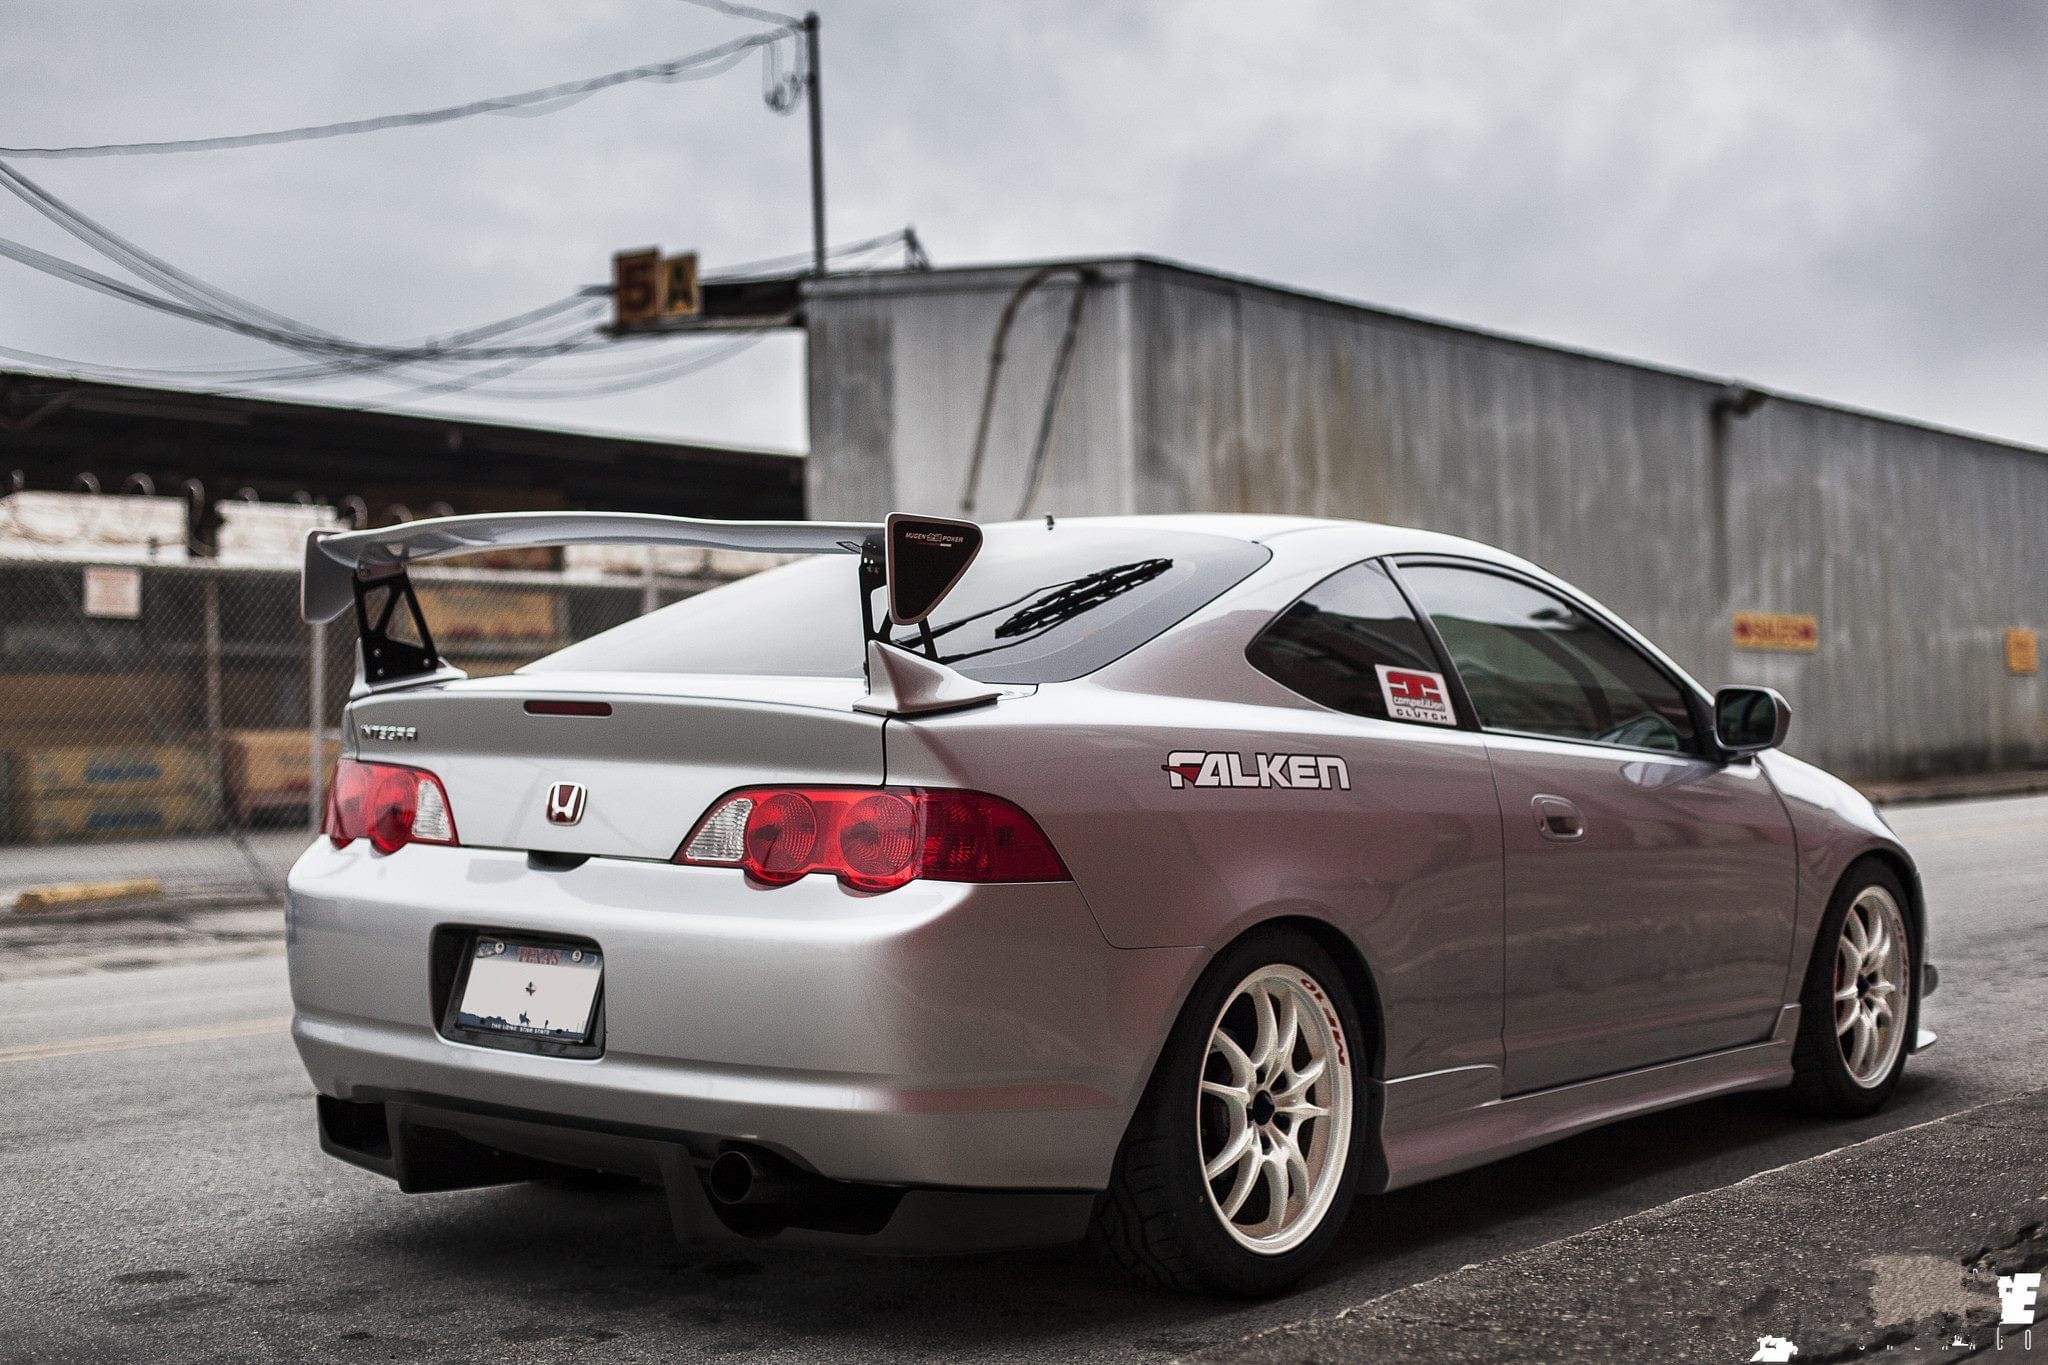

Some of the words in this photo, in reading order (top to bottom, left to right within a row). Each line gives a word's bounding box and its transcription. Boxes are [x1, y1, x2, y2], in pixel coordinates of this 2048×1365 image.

[905, 532, 927, 540] MUGEN
[942, 535, 964, 543] POWER
[1396, 708, 1448, 721] CLUTCH
[1162, 750, 1351, 790] FALKEN
[517, 945, 560, 966] TEXAS
